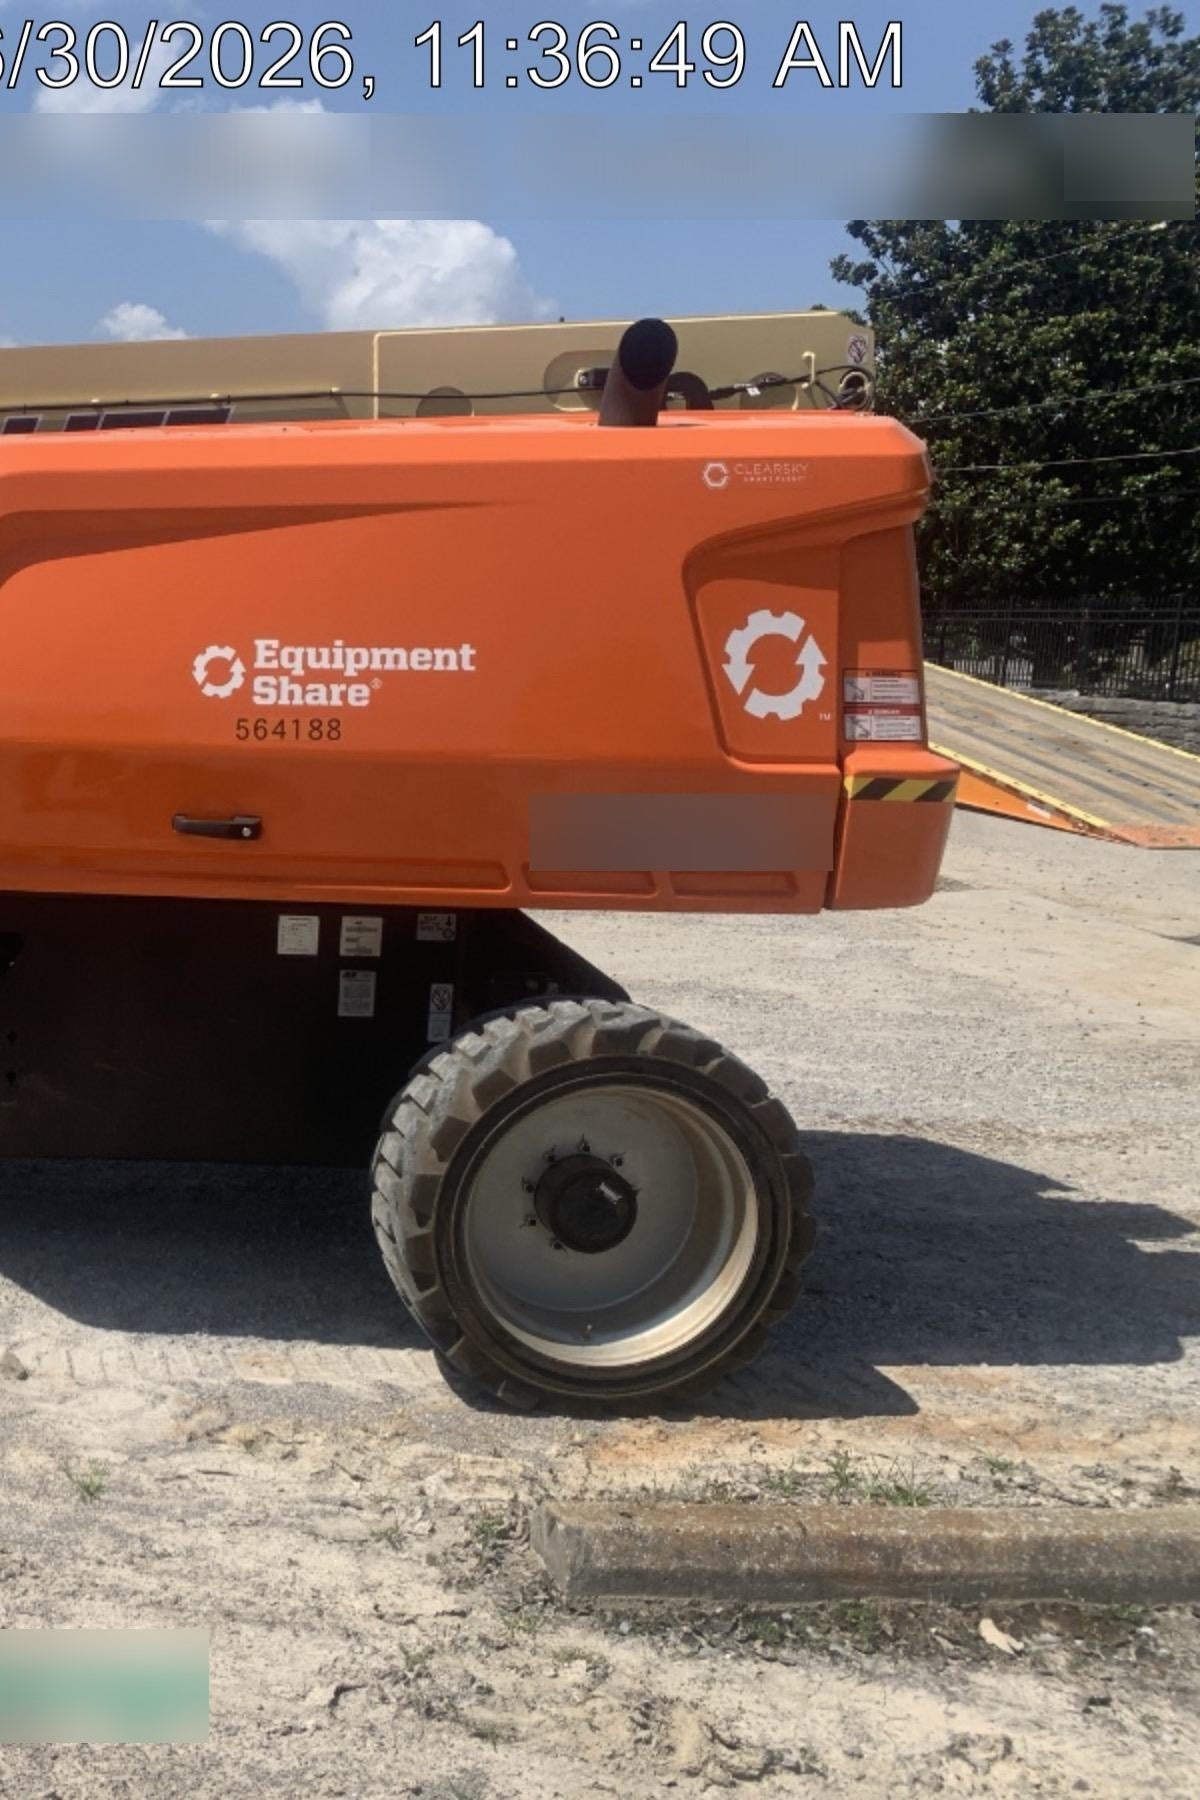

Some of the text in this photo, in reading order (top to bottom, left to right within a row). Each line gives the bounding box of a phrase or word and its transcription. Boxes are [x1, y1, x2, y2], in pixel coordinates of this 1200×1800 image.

[734, 463, 809, 475] CLEARSKY
[253, 639, 476, 676] Equipment
[235, 718, 341, 740] 564188
